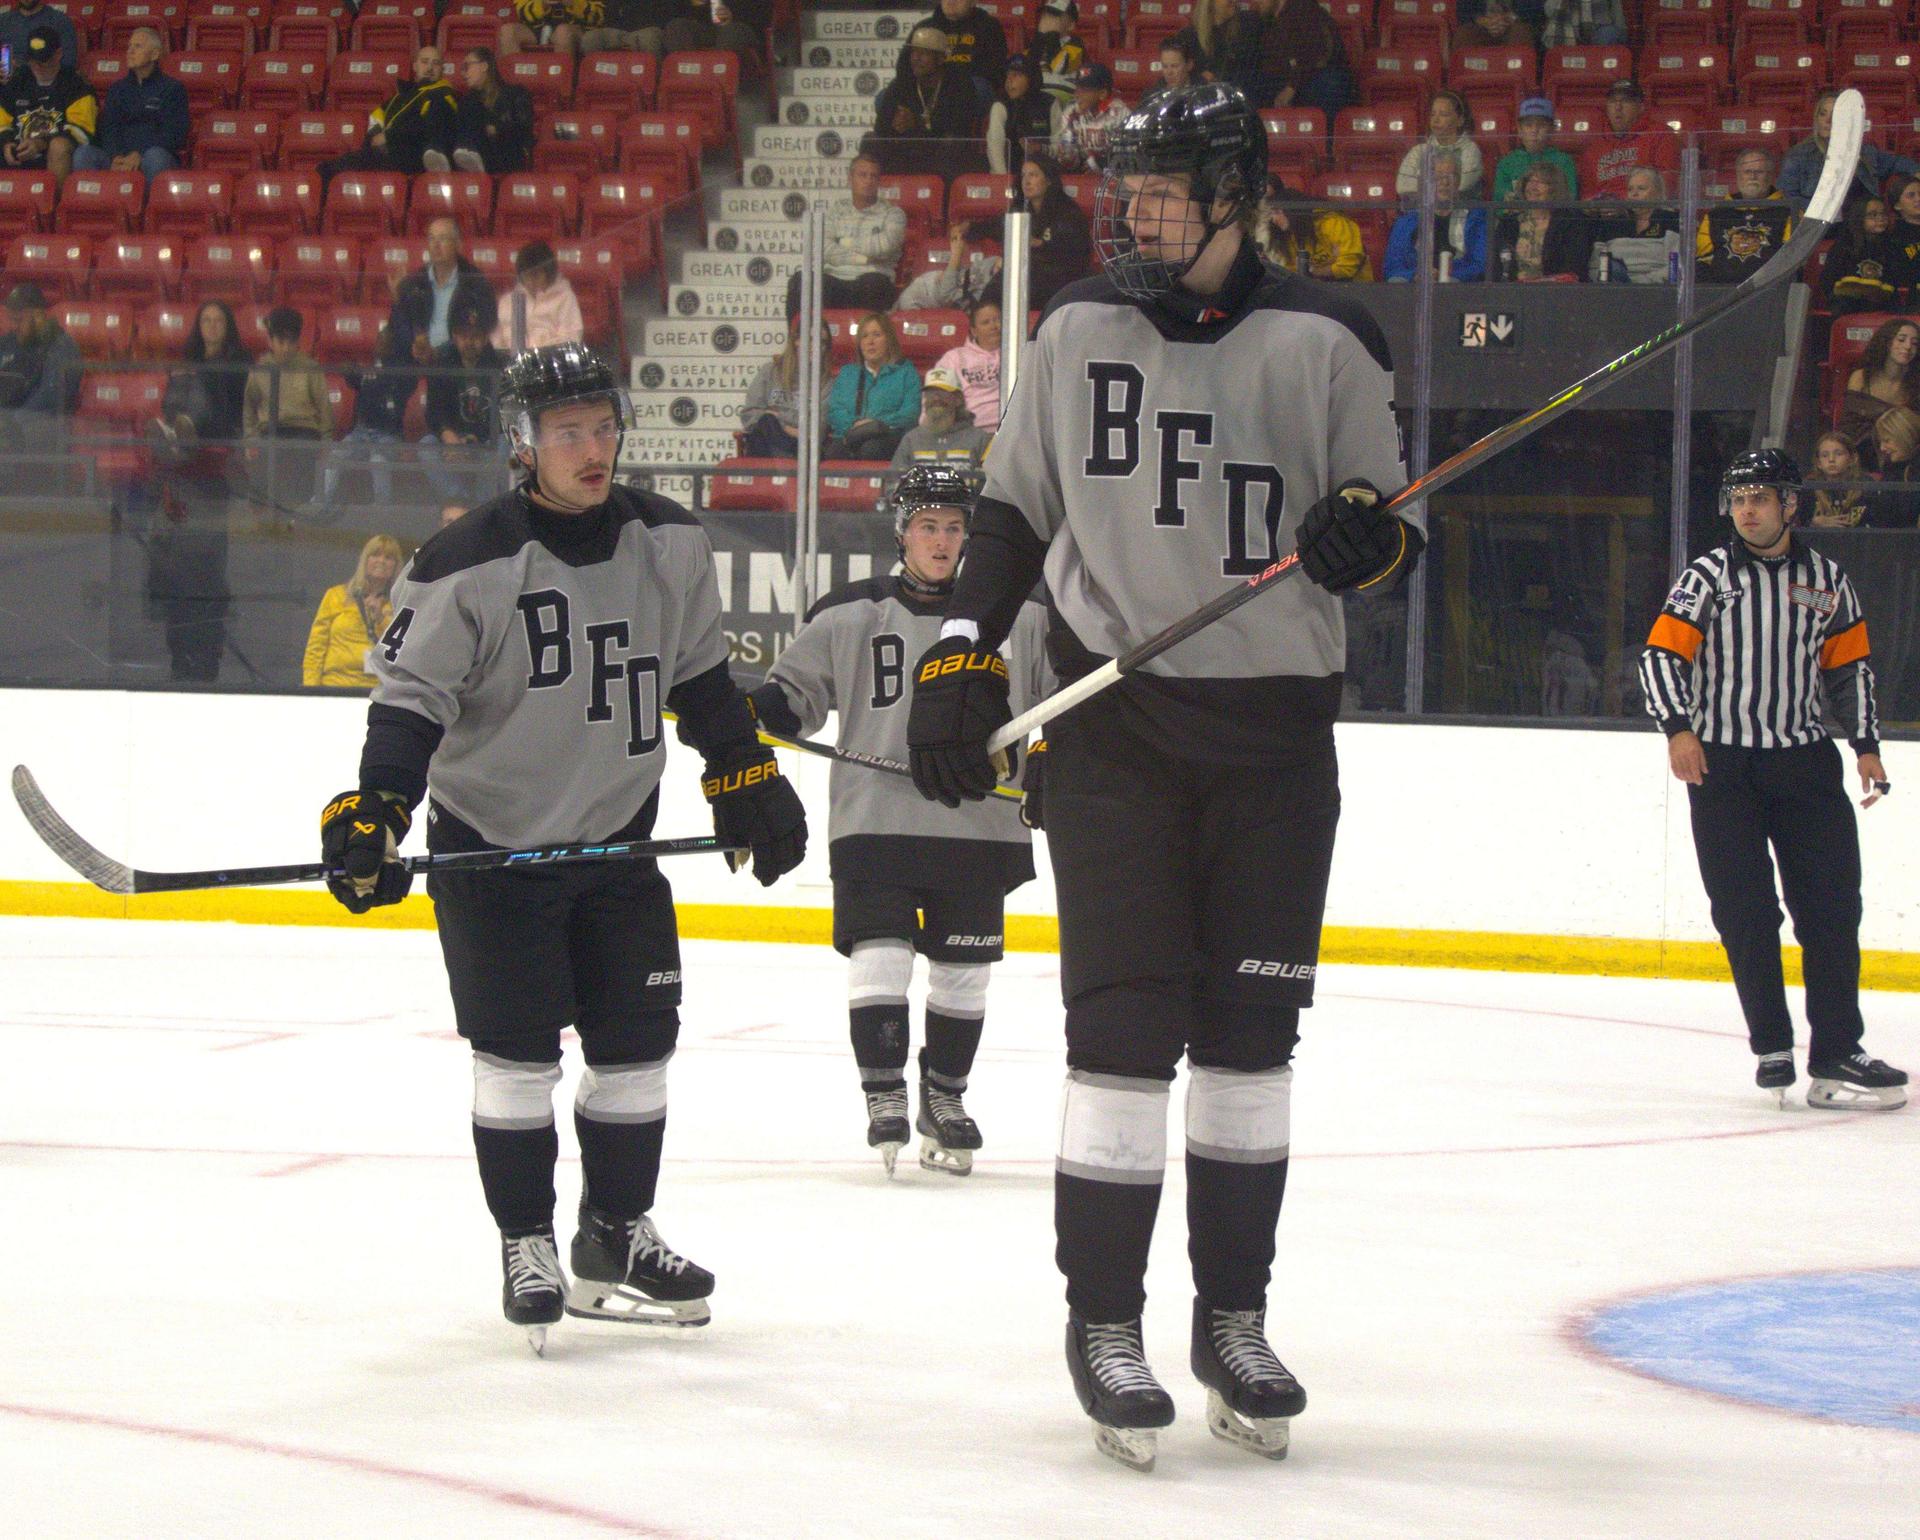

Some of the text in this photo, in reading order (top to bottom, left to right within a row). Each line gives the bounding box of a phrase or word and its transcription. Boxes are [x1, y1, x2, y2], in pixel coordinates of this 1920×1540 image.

[823, 22, 872, 34] GREAT
[801, 77, 852, 89] GREAT
[761, 137, 812, 150] GREAT
[728, 201, 777, 213] GREAT
[745, 230, 786, 240] GREAT
[690, 264, 743, 277] GREAT
[706, 293, 750, 303] GREAT
[653, 332, 709, 346] GREAT
[670, 365, 761, 375] GREAT KITC
[636, 404, 666, 418] EAT
[627, 437, 677, 449] GREAT
[919, 652, 1010, 683] BAUE
